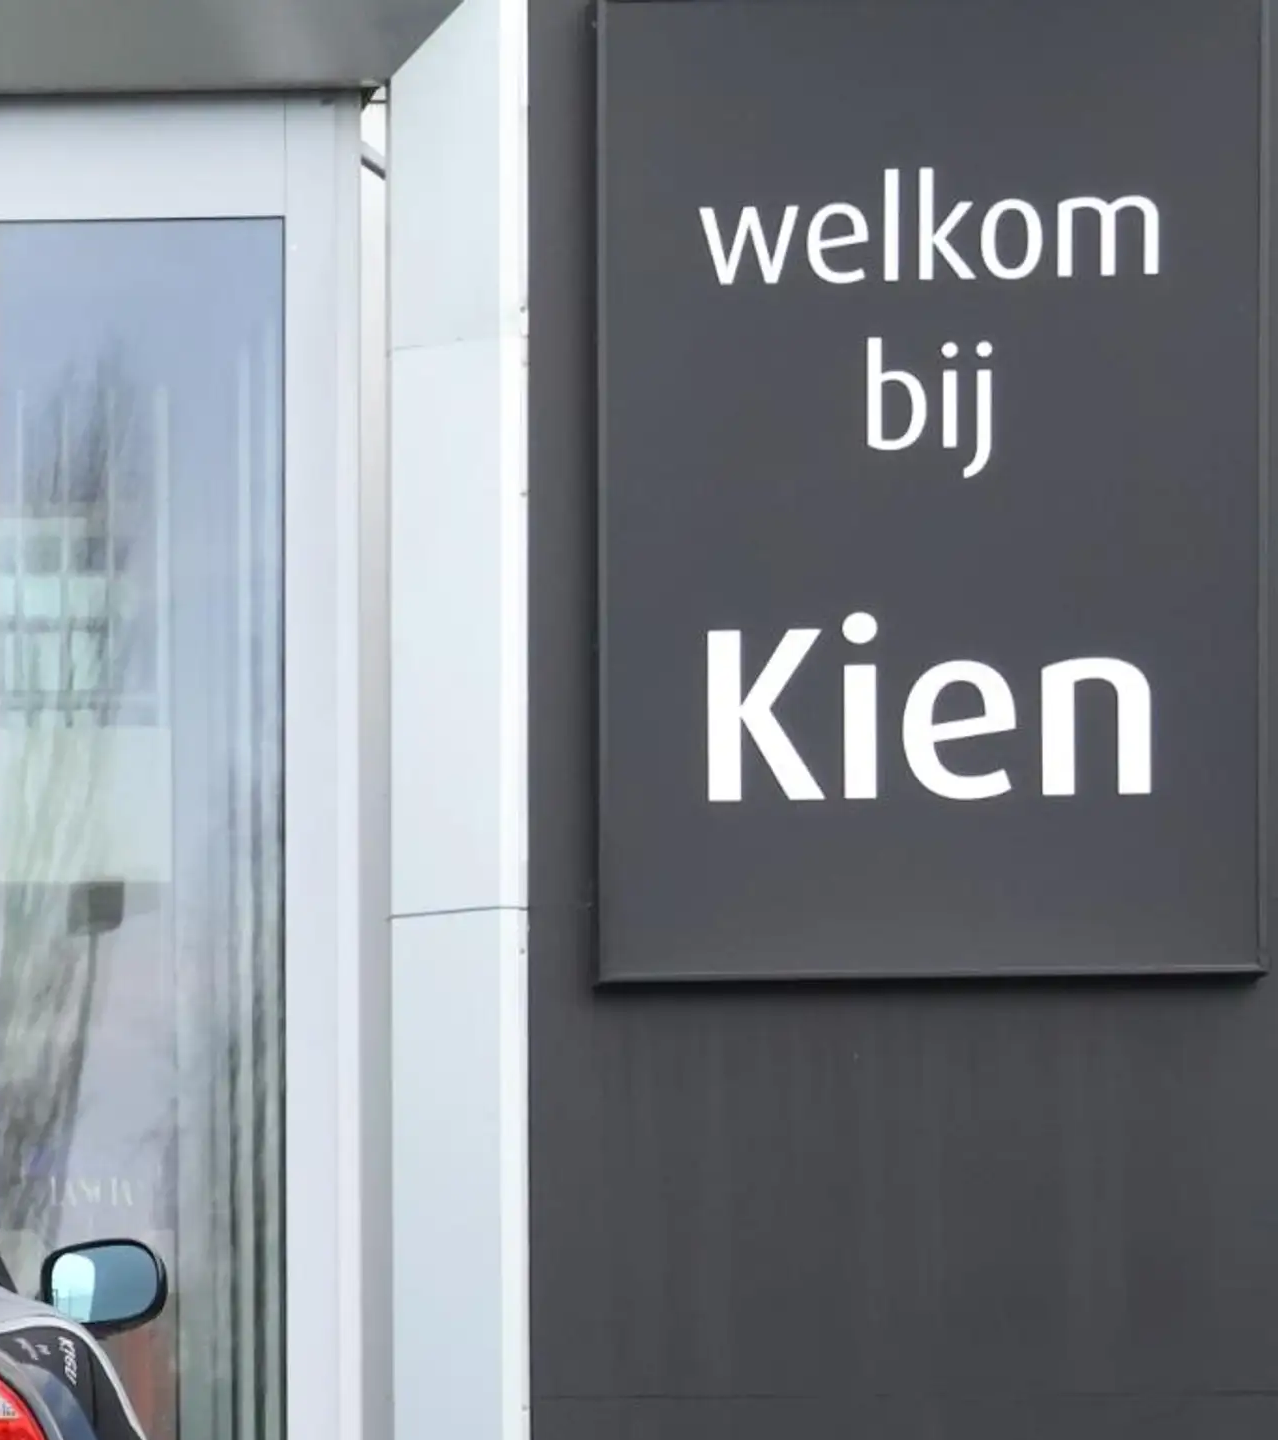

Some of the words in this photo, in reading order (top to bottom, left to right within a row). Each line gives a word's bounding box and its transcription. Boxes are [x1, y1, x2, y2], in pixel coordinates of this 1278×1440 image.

[698, 166, 1160, 286] welkom
[866, 336, 994, 479] bij
[706, 611, 1153, 803] Kien
